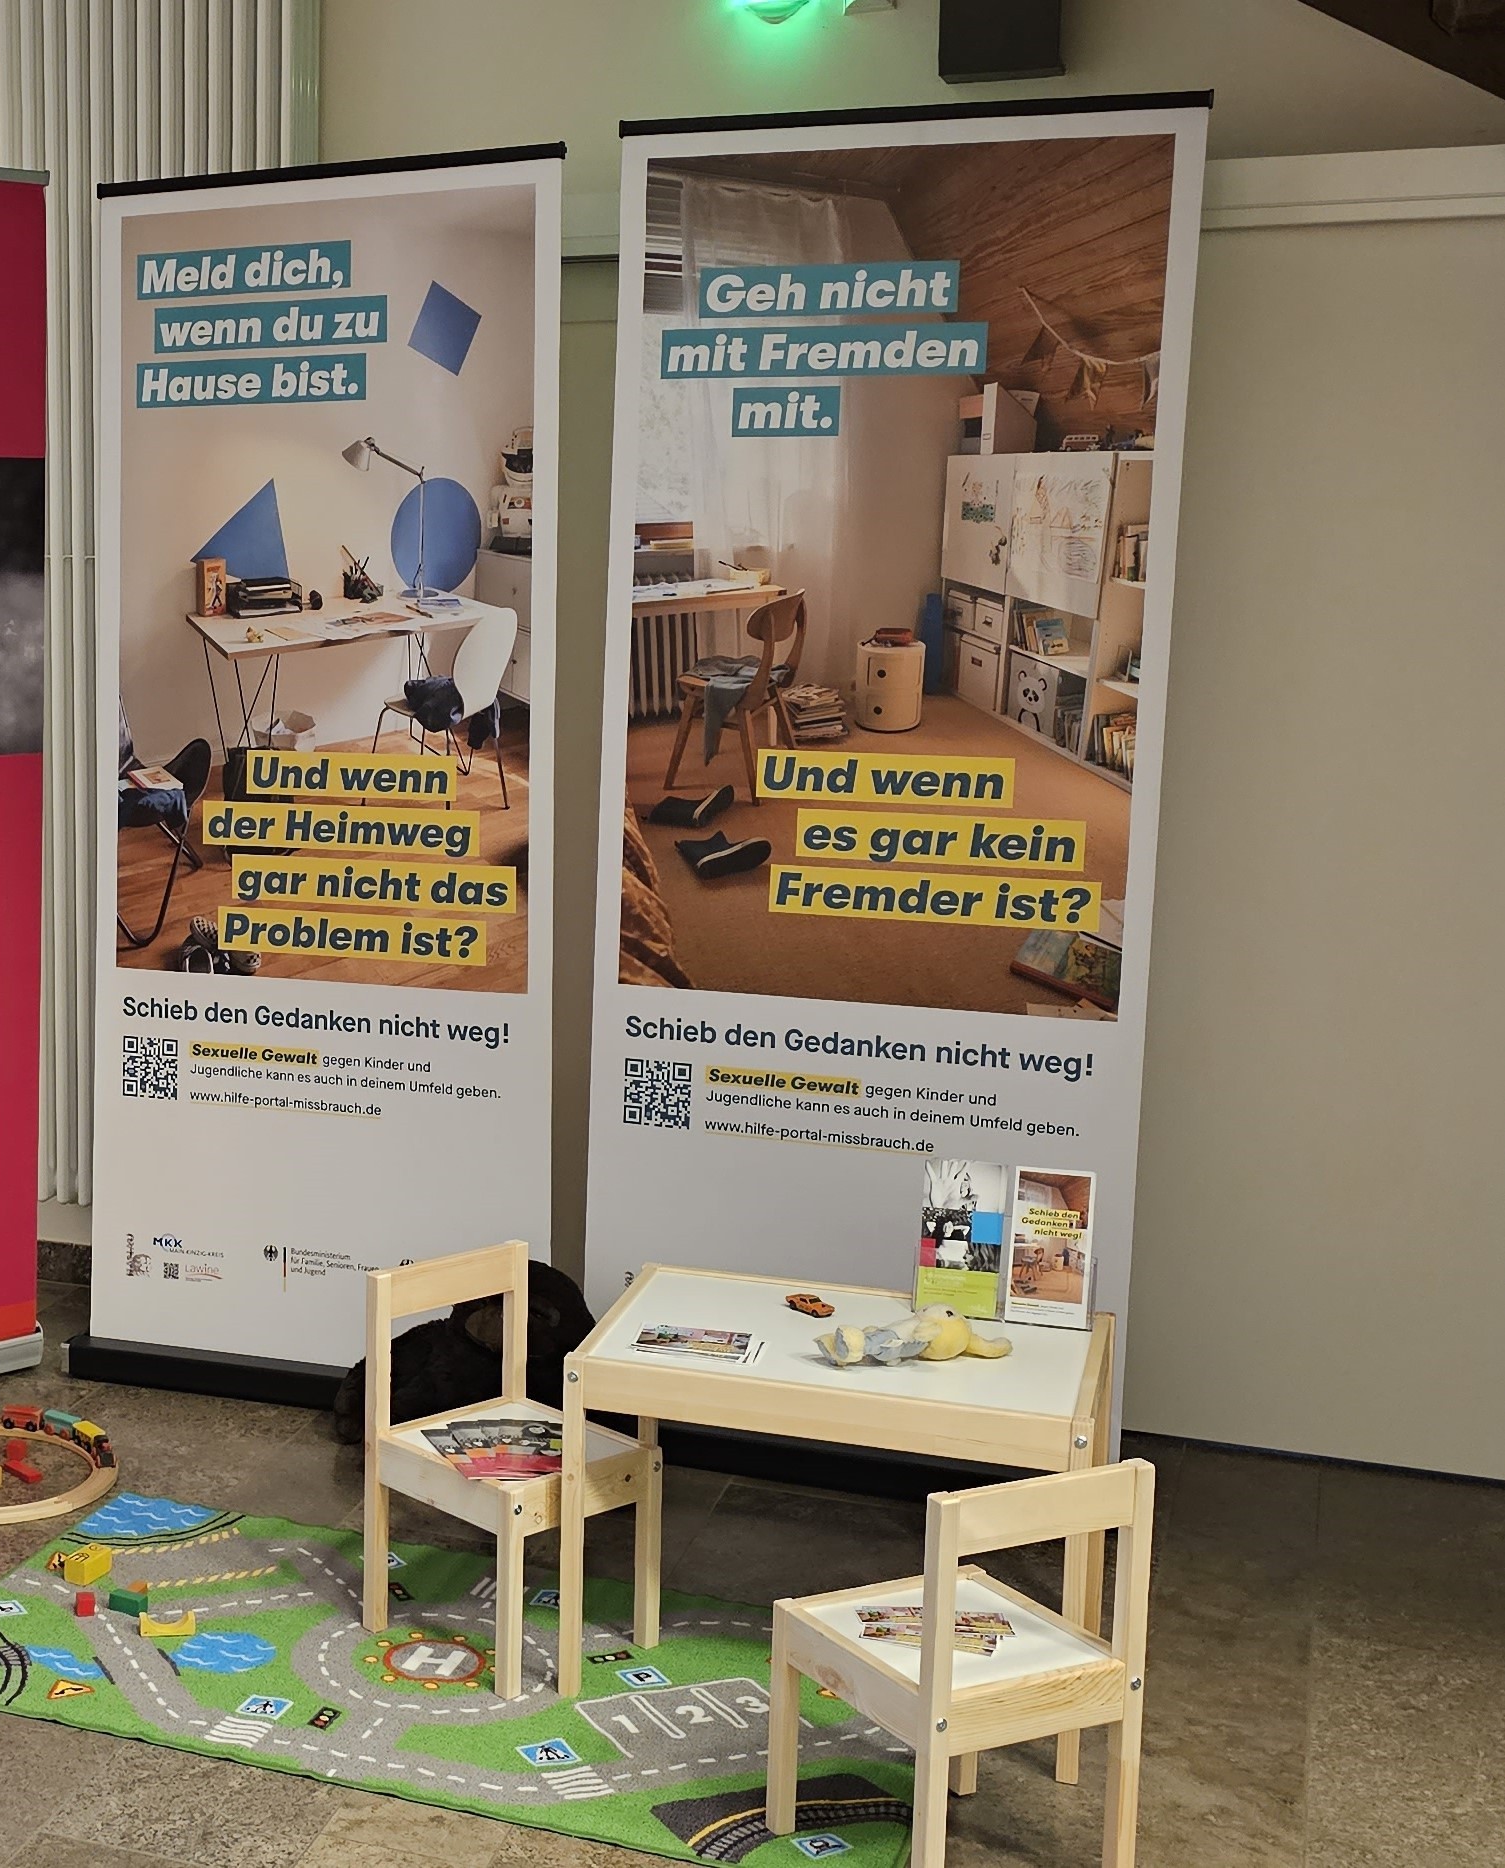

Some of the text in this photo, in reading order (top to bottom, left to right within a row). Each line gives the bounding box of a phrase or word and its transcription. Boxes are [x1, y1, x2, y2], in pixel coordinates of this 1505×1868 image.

[142, 249, 344, 294] Meld dich,
[705, 269, 951, 313] Geh nicht
[159, 306, 380, 347] wenn du zu
[667, 330, 979, 372] mit Fremden
[141, 361, 359, 402] Hause bist.
[737, 391, 833, 429] mit.
[252, 756, 450, 795] Und wenn
[763, 756, 1004, 800] Und wenn
[208, 808, 472, 858] der Heimweg
[803, 823, 1076, 863] es gar kein
[238, 866, 508, 907] gar nicht das
[776, 871, 1092, 924] Fremder ist?
[224, 913, 479, 959] Problem ist?
[122, 996, 510, 1048] Schieb den Gedanken nicht weg!
[192, 1043, 431, 1073] Sexuelle Gewalt gegen Kinder und
[625, 1015, 1094, 1083] Schieb den Gedanken nicht weg!
[190, 1063, 502, 1099] Jugendliche kann es auch in deinem Umfeld geben.
[708, 1068, 997, 1106] Sexuelle Gewalt gegen Kinder und
[190, 1090, 382, 1117] www.hilfe-portal-missbrauch.de
[706, 1089, 1080, 1137] Jugendliche kann es auch in deinem Umfeld geben.
[705, 1119, 934, 1153] www.hilfe-portal-missbrauch.de
[1021, 1217, 1068, 1228] Gedanken
[1029, 1208, 1059, 1217] Schieb
[153, 1236, 183, 1249] MKK
[291, 1247, 351, 1260] Bundesministerium
[1060, 1231, 1082, 1240] weg!
[184, 1263, 220, 1274] Lawine
[302, 1258, 324, 1267] Familie,
[326, 1260, 356, 1271] Senioren,
[304, 1267, 326, 1276] Jugend
[611, 1714, 640, 1734] 1
[675, 1705, 714, 1724] 2
